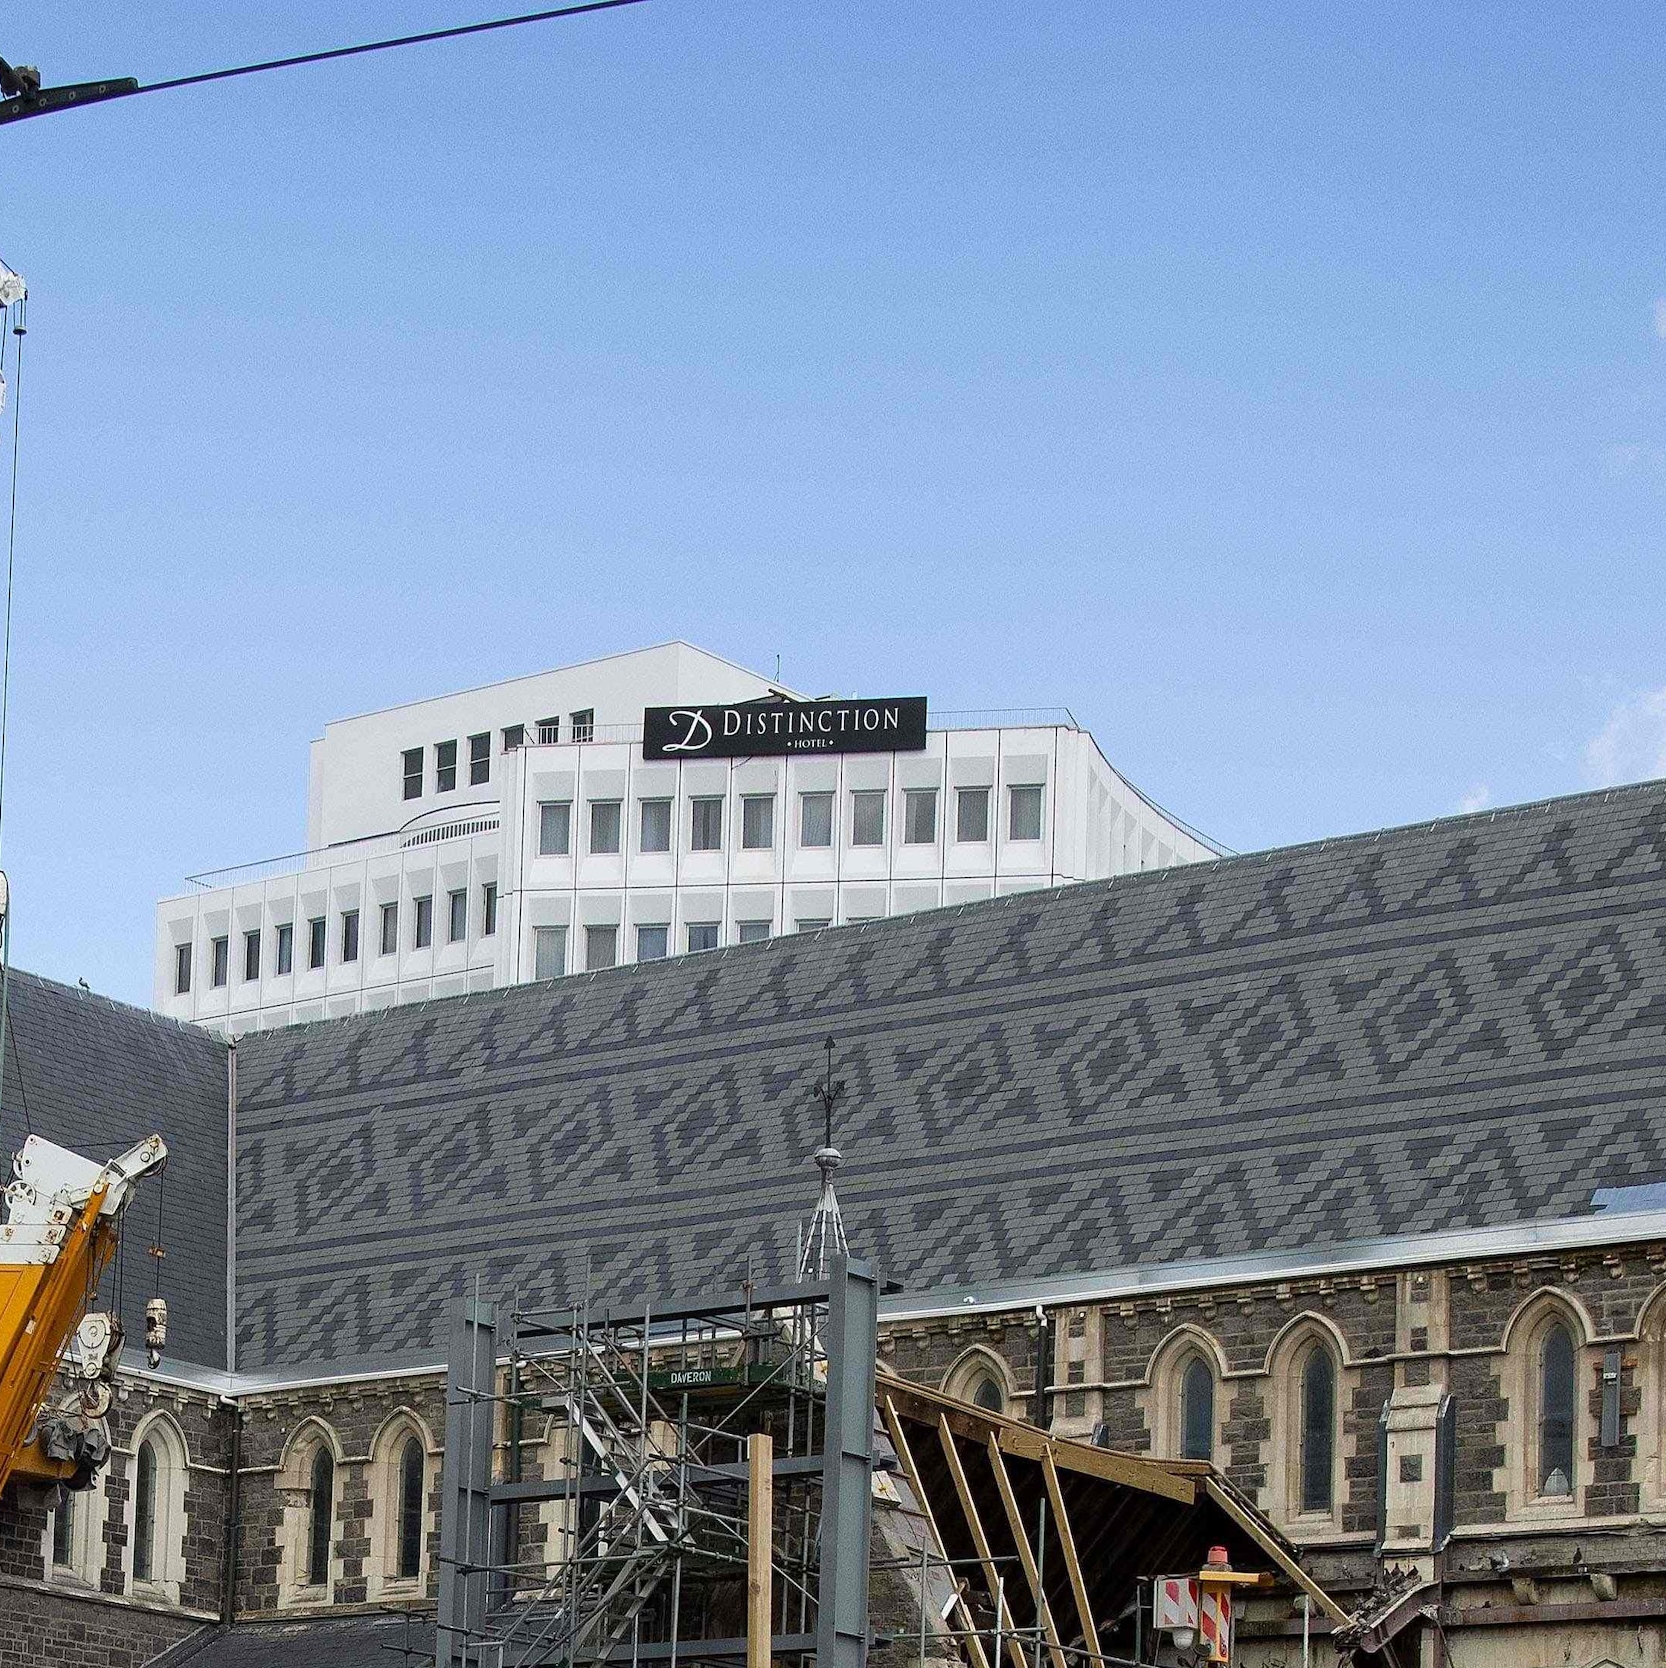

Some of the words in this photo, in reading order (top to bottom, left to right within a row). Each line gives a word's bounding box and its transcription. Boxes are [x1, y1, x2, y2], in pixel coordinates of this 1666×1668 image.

[722, 707, 900, 736] DISTINCTION
[794, 739, 827, 749] HOTEL
[670, 1370, 712, 1384] DAVERON
